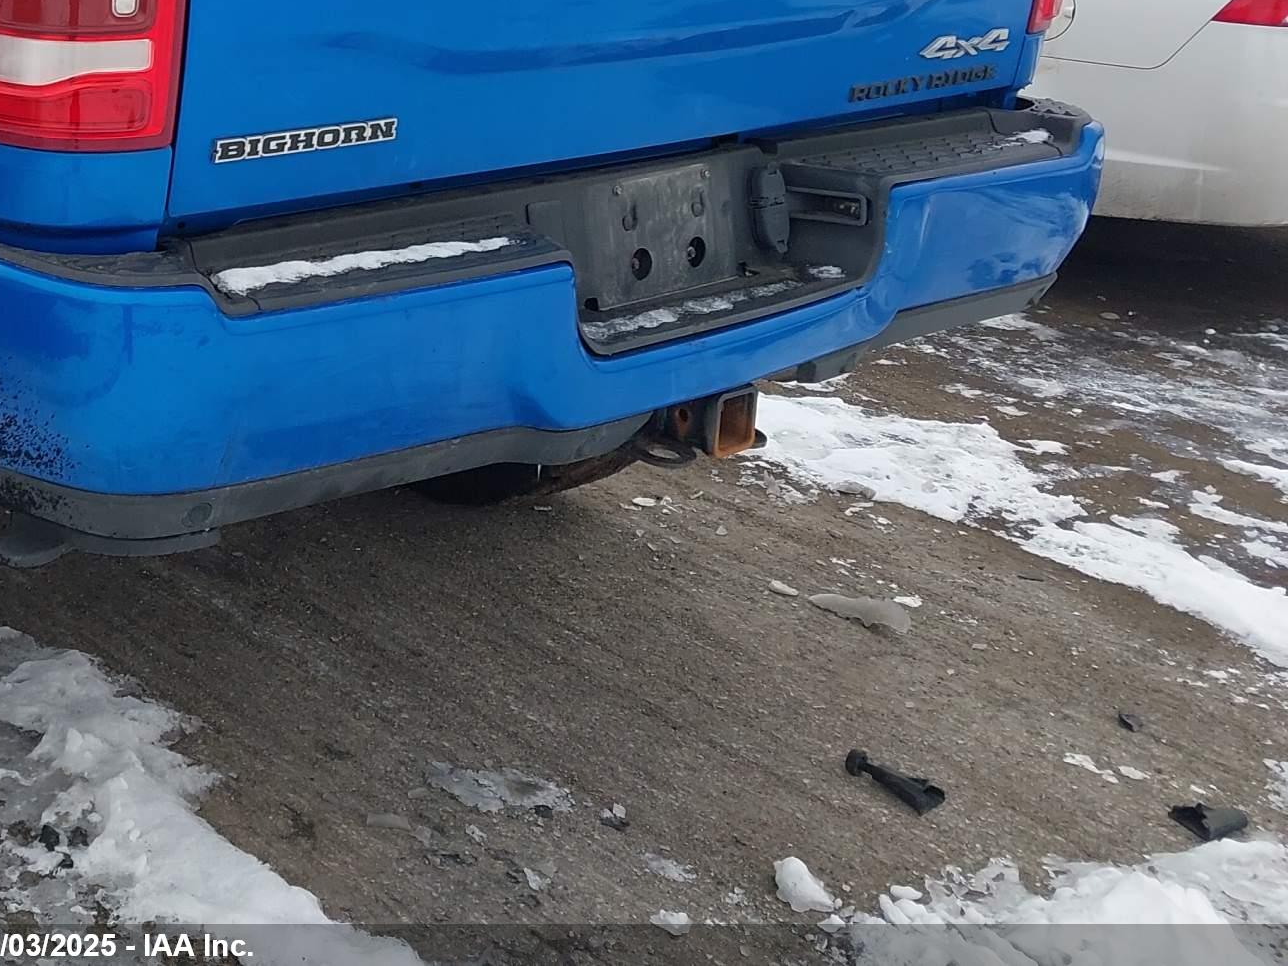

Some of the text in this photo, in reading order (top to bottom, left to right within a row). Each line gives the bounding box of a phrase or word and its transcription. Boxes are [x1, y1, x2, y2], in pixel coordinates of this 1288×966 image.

[848, 63, 998, 103] ROCKY RIDGE
[215, 118, 398, 163] BIGHORN
